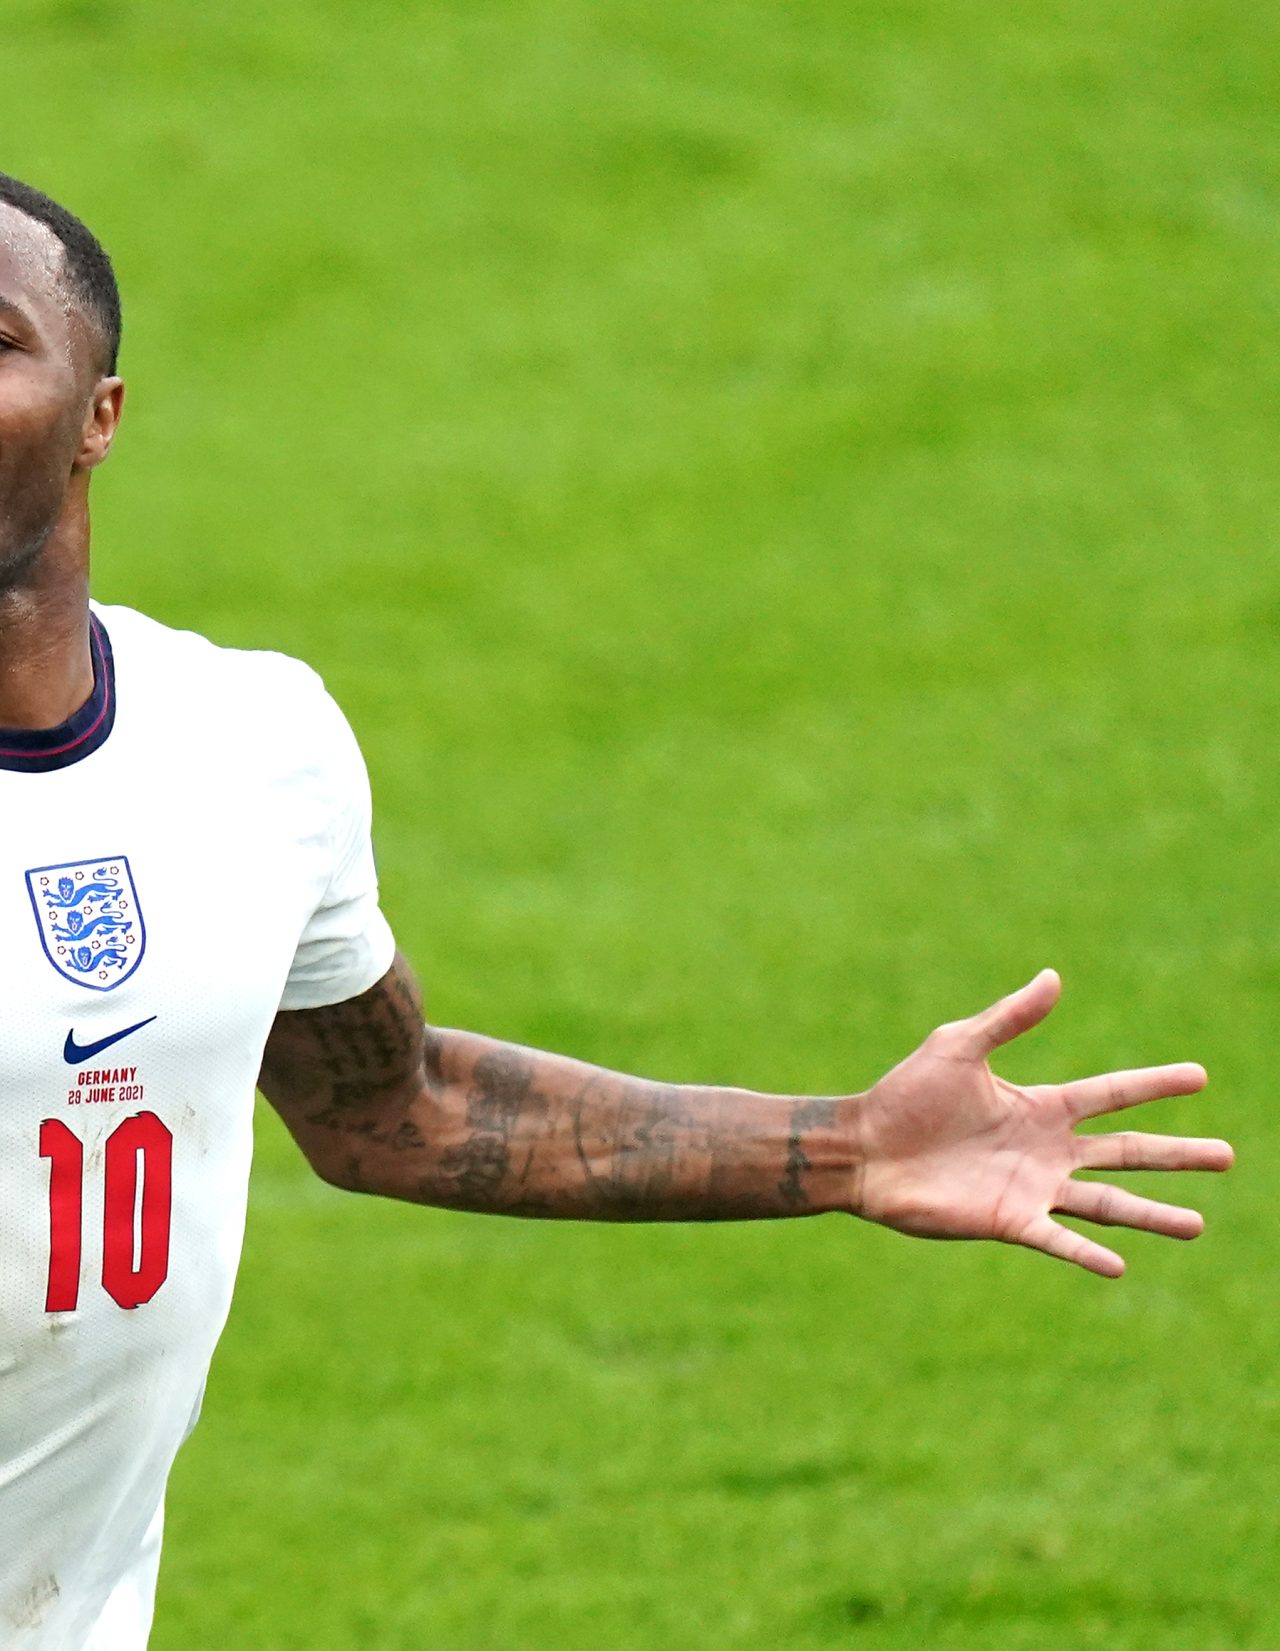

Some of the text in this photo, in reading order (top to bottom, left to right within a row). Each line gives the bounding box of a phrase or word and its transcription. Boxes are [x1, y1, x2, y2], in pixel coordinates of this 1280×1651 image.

[78, 1067, 137, 1086] GERMANY
[85, 1088, 115, 1104] JUNE
[119, 1086, 144, 1101] 2021
[39, 1110, 173, 1313] 10
